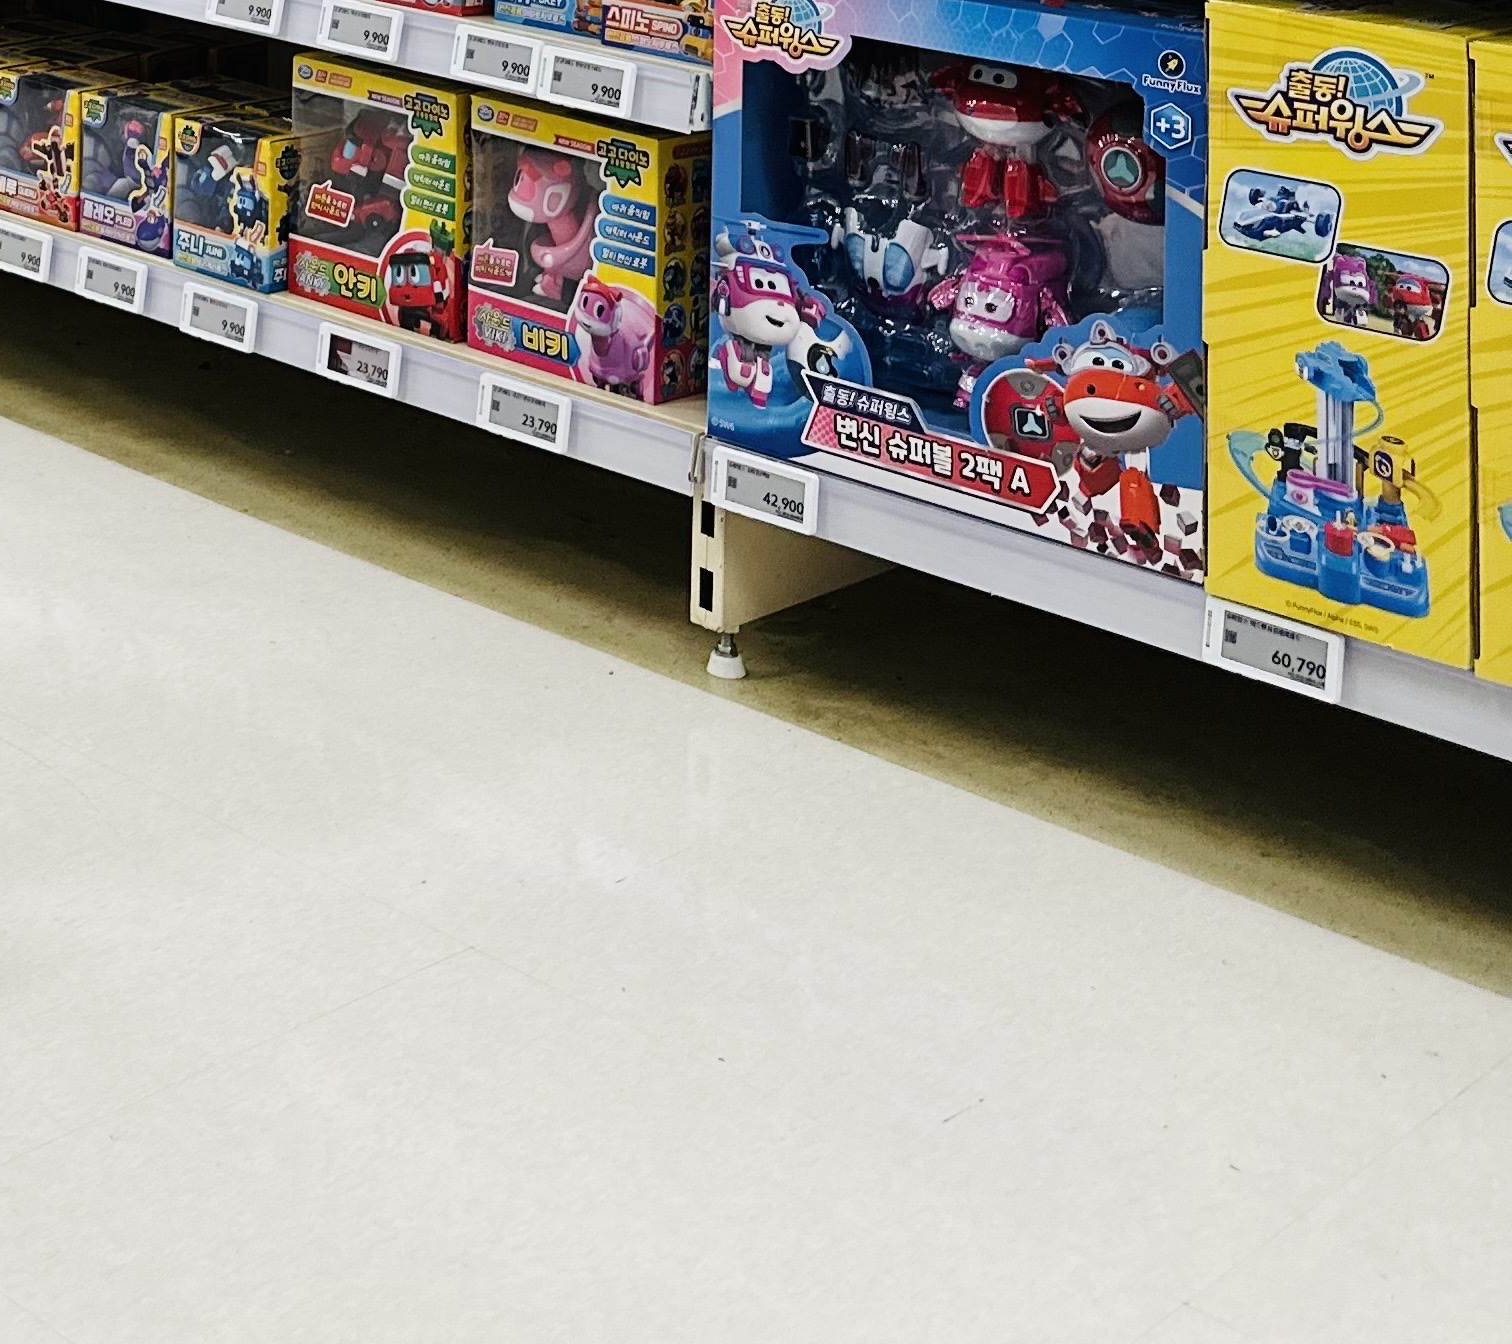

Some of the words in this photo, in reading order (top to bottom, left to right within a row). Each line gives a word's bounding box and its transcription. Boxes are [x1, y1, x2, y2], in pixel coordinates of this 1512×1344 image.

[247, 4, 272, 21] 9,900
[606, 6, 650, 32] 스피노
[652, 18, 678, 34] SPINO
[755, 3, 790, 25] 출동!
[363, 28, 390, 45] 9,900
[727, 19, 838, 58] 슈퍼윙스
[501, 60, 530, 78] 9,900
[591, 83, 621, 102] 9,900
[1143, 75, 1201, 95] FunnyFlux
[1287, 69, 1349, 100] 출동!
[404, 95, 450, 119] 고고다이노
[1235, 91, 1436, 153] 슈퍼윙스
[597, 142, 649, 168] 고고다이노
[178, 232, 204, 255] 주니
[21, 252, 40, 268] 9,900
[114, 281, 135, 298] 9,900
[333, 263, 377, 301] 안키
[222, 319, 245, 337] 9,900
[522, 322, 569, 361] 비키
[356, 359, 389, 381] 23,790
[822, 385, 856, 408] 출동!
[858, 397, 911, 423] 슈퍼윙스
[521, 413, 558, 436] 23,790
[836, 416, 880, 454] 변신
[888, 437, 953, 476] 슈퍼볼
[960, 453, 1002, 490] 2팩
[1011, 467, 1030, 494] A
[763, 492, 804, 515] 42,900
[1271, 650, 1326, 679] 60,790
